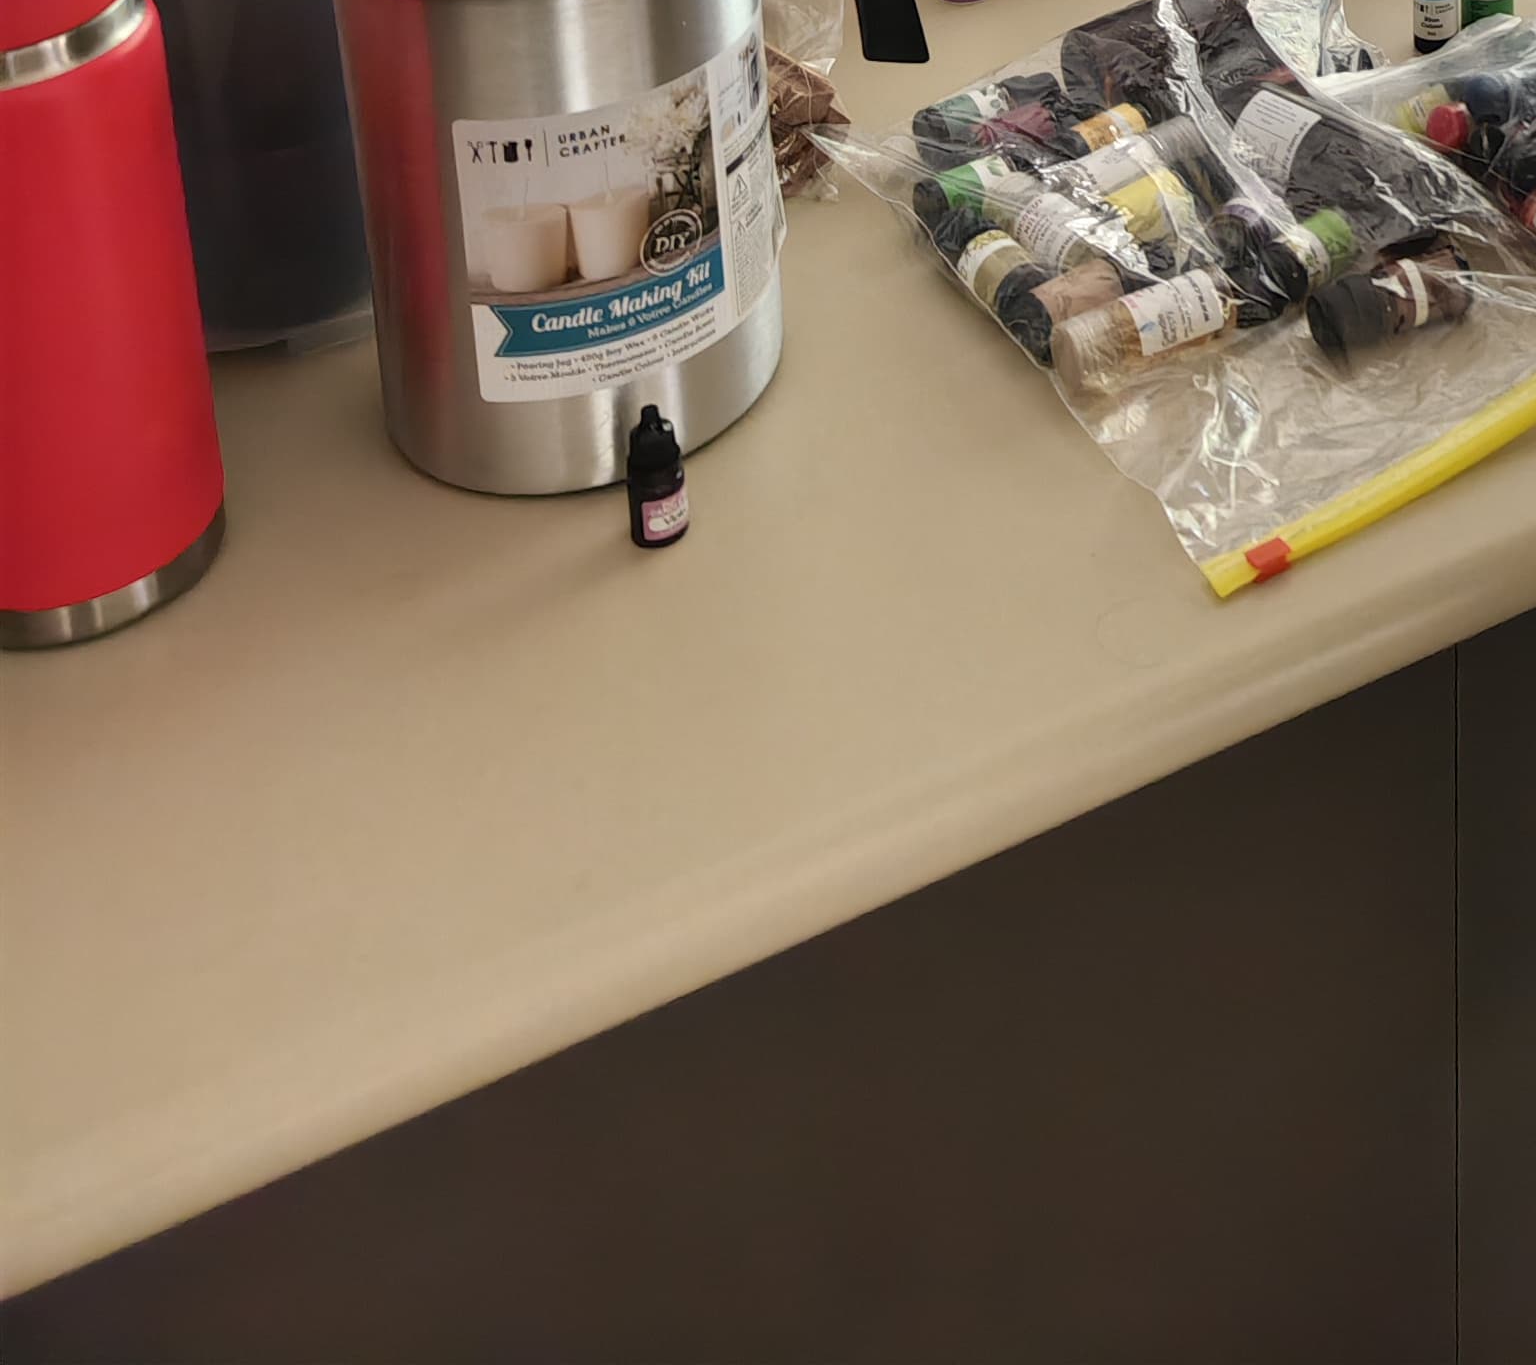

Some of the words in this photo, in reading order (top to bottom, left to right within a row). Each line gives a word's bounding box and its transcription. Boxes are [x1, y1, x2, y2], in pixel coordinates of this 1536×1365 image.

[558, 124, 611, 145] URBAN
[655, 231, 690, 254] DIY
[531, 307, 604, 334] Candle
[608, 280, 683, 320] Making
[686, 261, 711, 288] Kit
[587, 322, 626, 340] Makes
